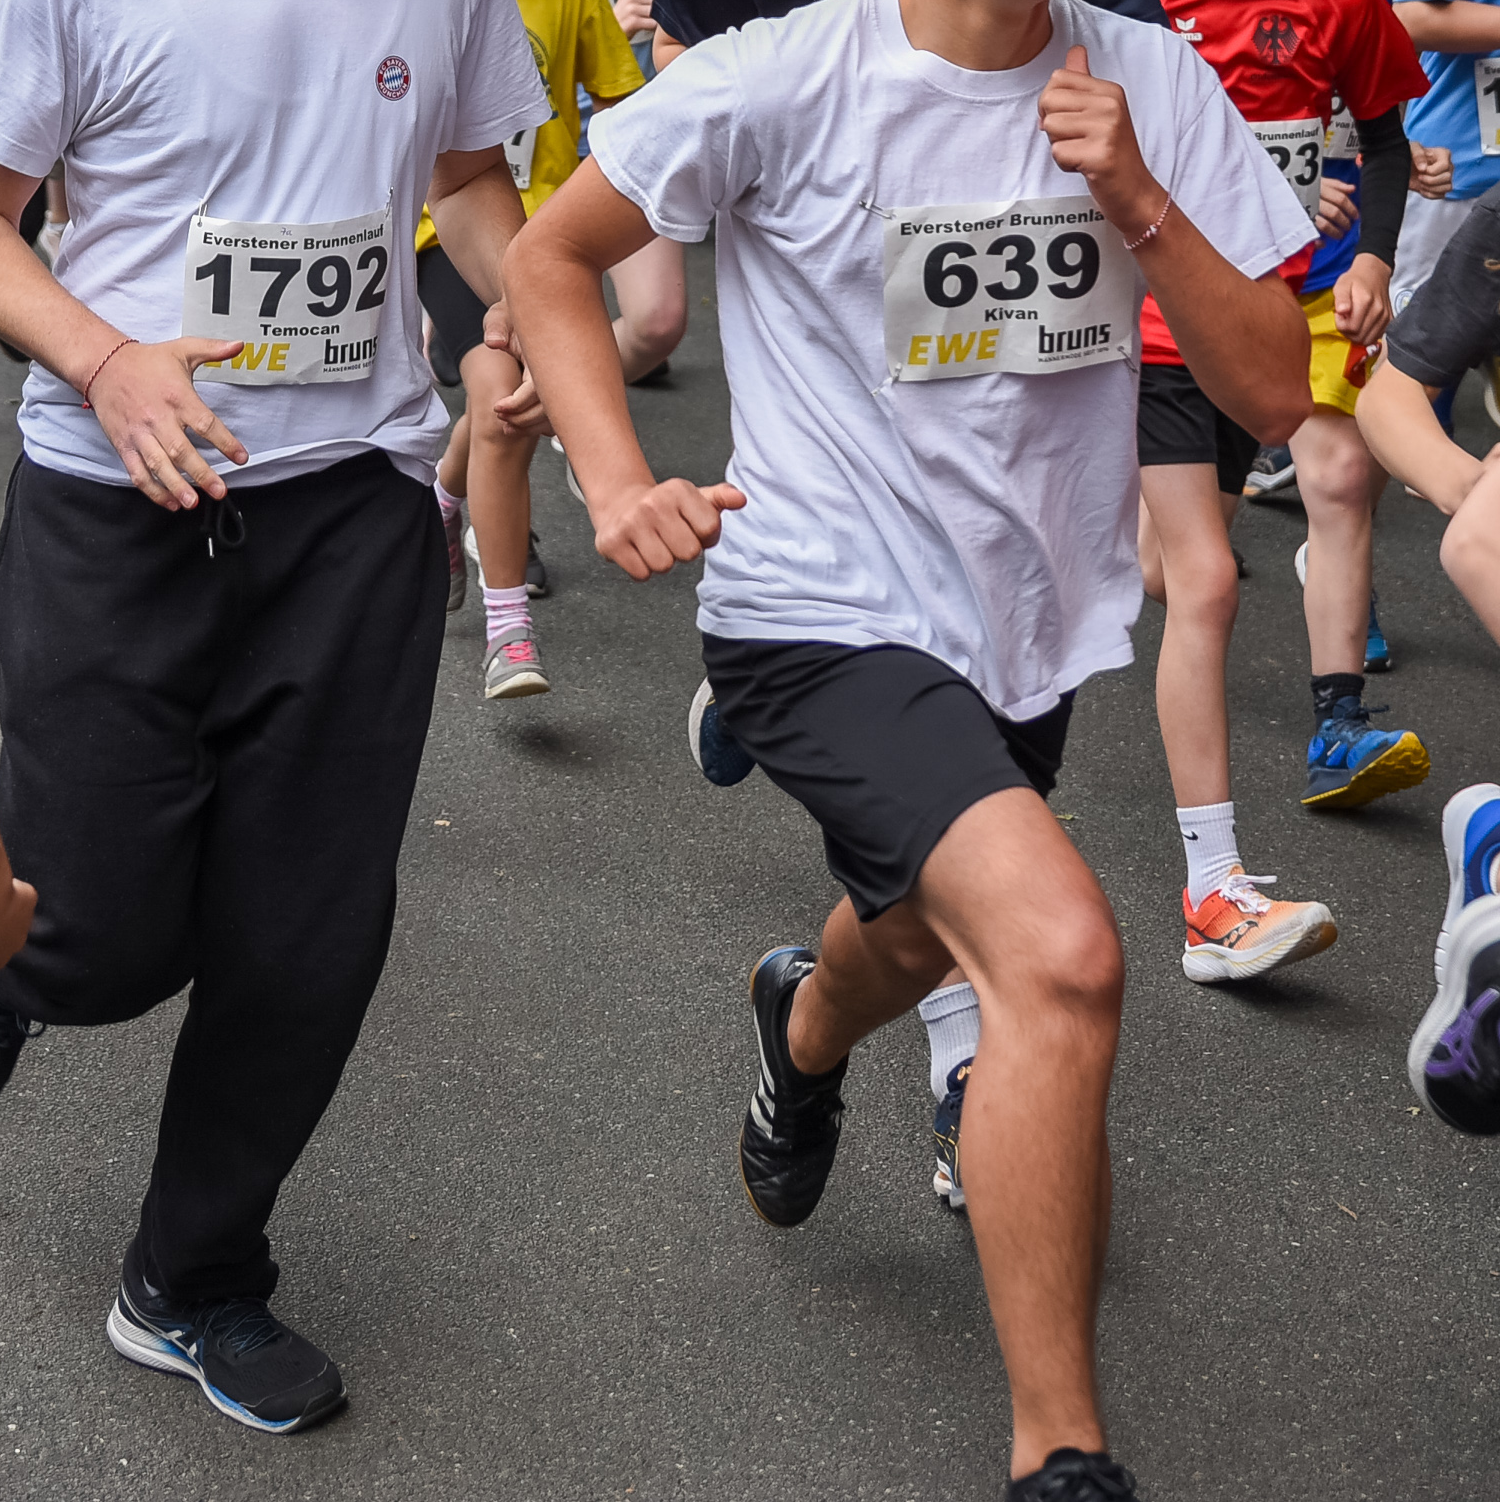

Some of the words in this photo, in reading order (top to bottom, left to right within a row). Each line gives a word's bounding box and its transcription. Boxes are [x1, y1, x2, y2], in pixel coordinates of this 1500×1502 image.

[202, 231, 299, 250] Everstener
[303, 224, 385, 250] Brunnenlauf
[900, 218, 1005, 236] Everstener
[1010, 208, 1105, 227] Brunnenla
[195, 245, 389, 318] 1792
[923, 231, 1101, 309] 639
[984, 307, 1039, 322] Kivan
[259, 323, 340, 337] Temocan
[1038, 323, 1112, 354] bruns
[203, 342, 291, 372] WE
[907, 327, 1000, 366] EWE
